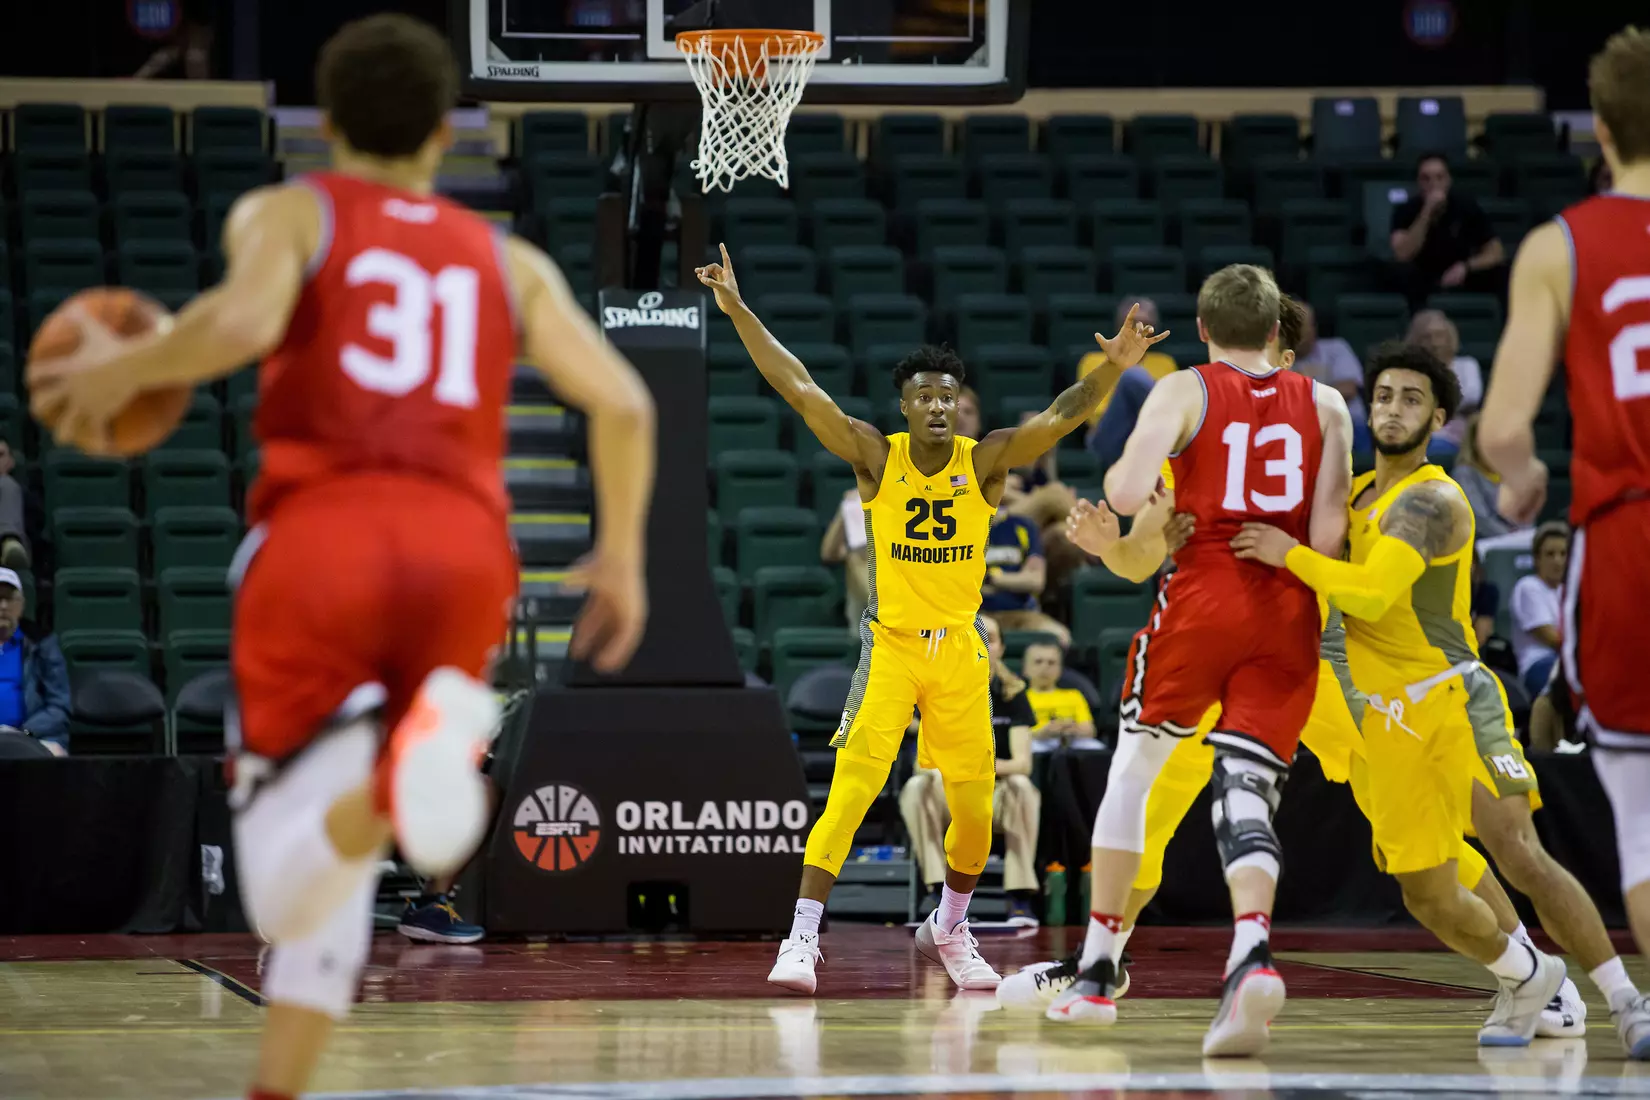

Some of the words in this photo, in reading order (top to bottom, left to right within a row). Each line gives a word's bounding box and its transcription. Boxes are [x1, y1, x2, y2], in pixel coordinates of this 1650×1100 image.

[487, 65, 539, 78] SPALDING
[340, 247, 479, 409] 31
[604, 306, 699, 330] SPALDING
[1222, 421, 1304, 512] 13
[905, 497, 957, 541] 25
[891, 542, 974, 564] MARQUETTE
[616, 800, 808, 831] ORLANDO
[535, 822, 581, 836] ESPN
[618, 835, 805, 854] INVITATIONAL
